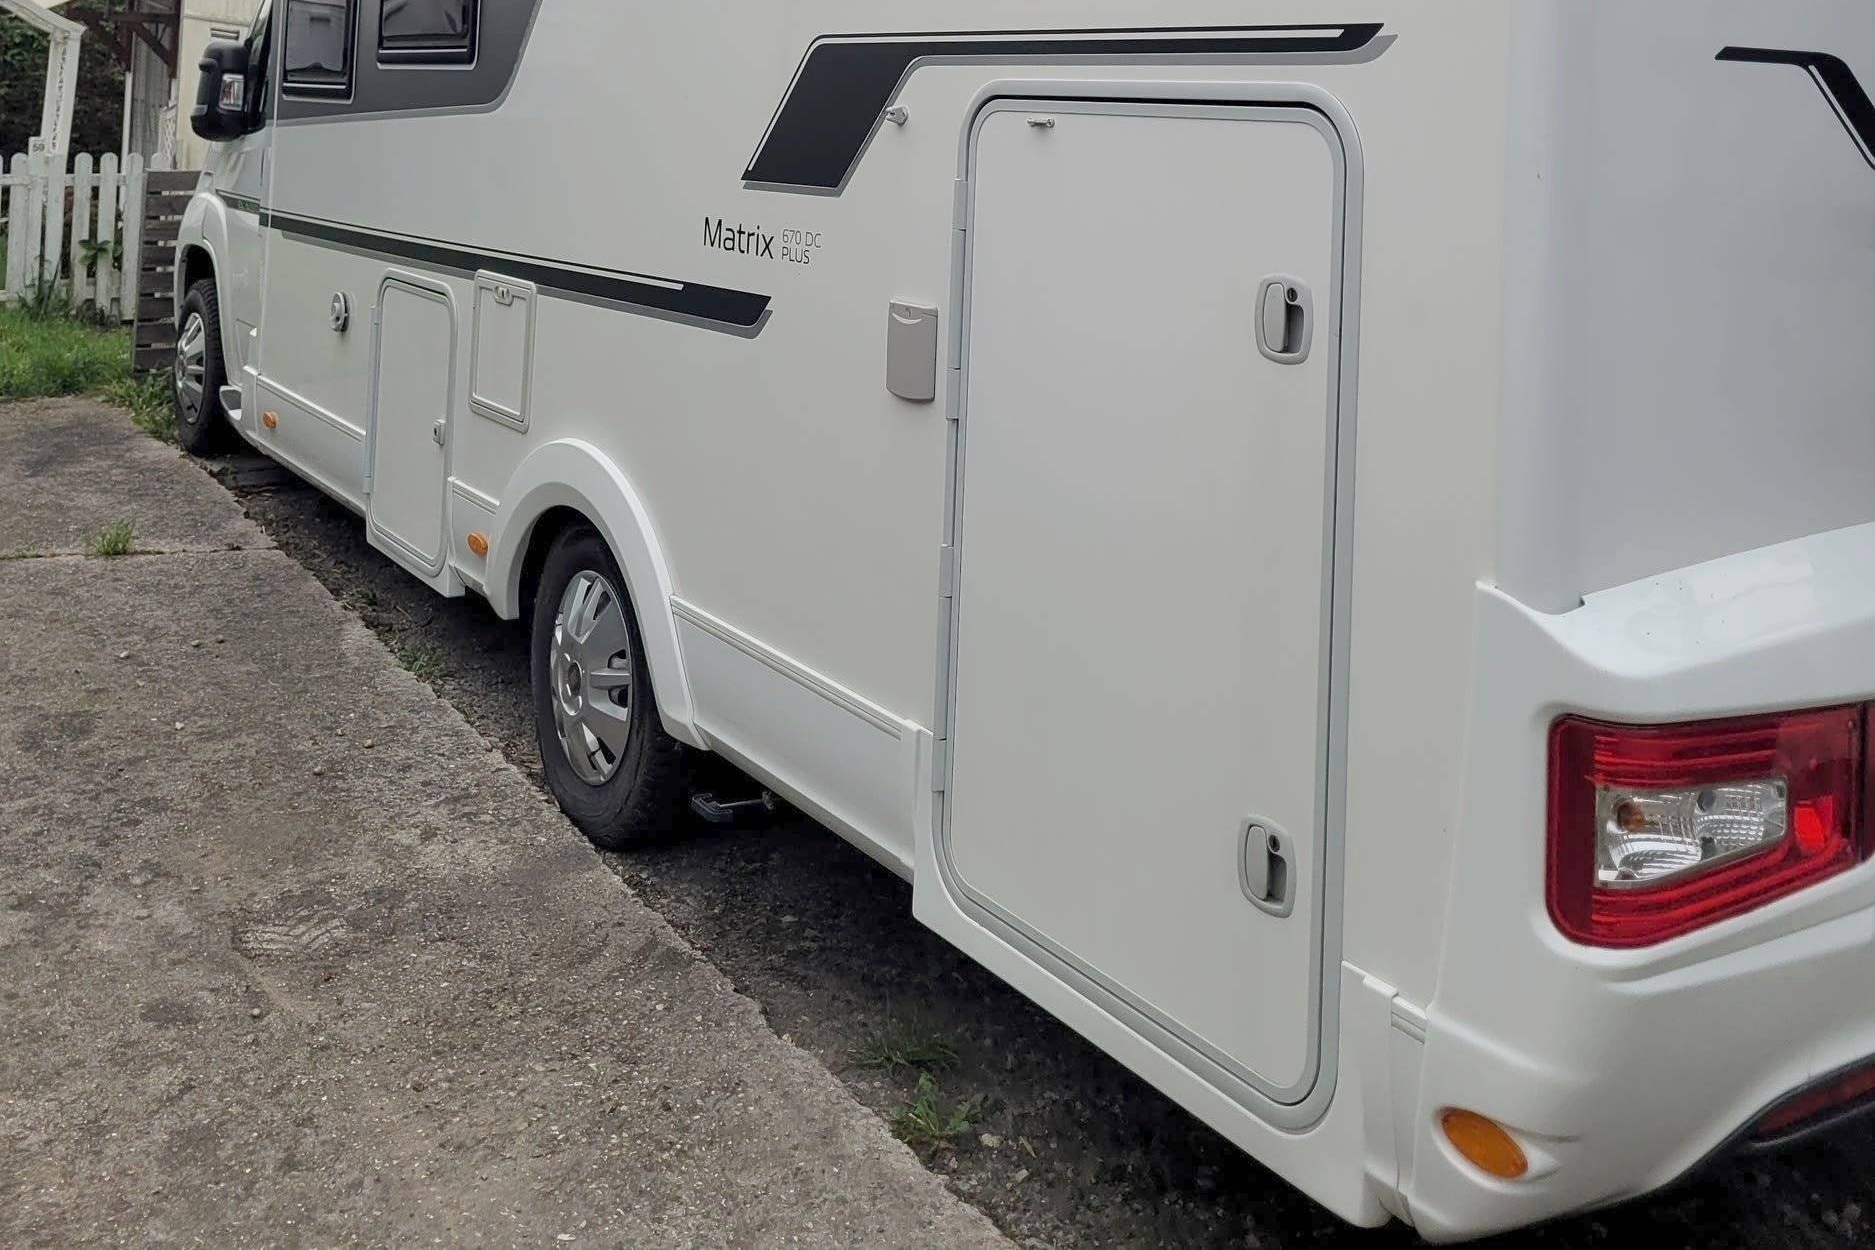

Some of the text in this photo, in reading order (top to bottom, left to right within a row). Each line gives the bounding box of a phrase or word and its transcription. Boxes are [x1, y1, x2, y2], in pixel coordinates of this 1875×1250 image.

[703, 216, 821, 259] Matrix 670 DC
[781, 246, 810, 264] PLUS
